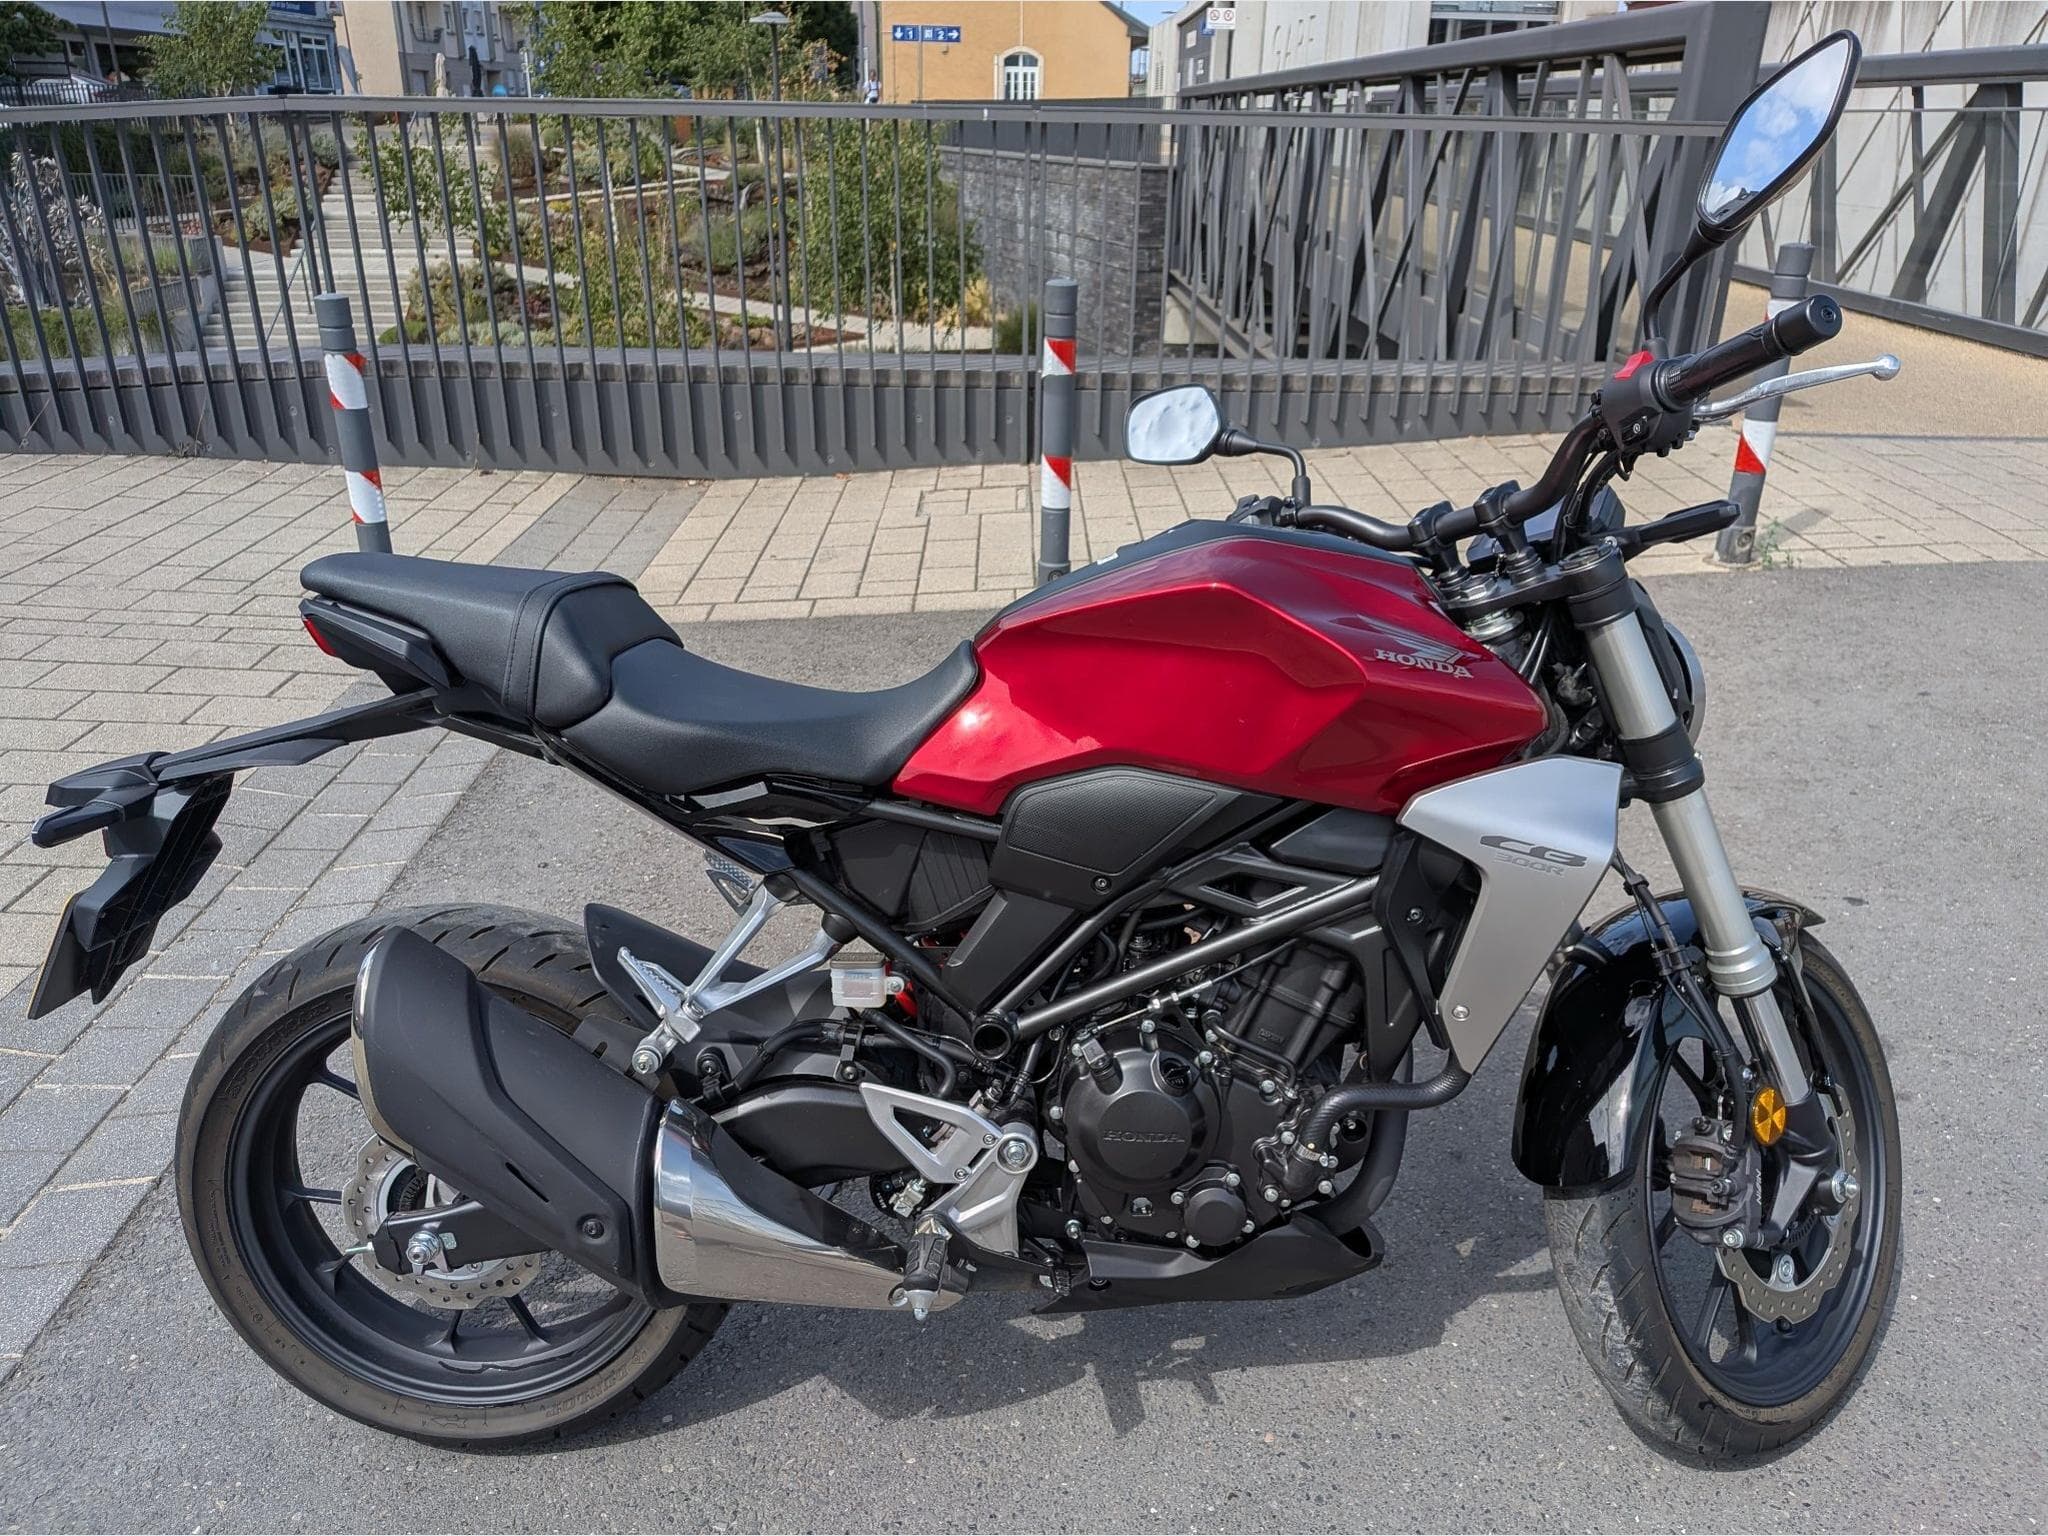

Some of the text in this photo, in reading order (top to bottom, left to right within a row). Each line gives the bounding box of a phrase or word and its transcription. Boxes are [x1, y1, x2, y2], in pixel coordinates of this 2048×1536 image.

[937, 30, 945, 40] 2
[1375, 648, 1474, 678] HONDA
[1103, 1130, 1185, 1143] HONDA
